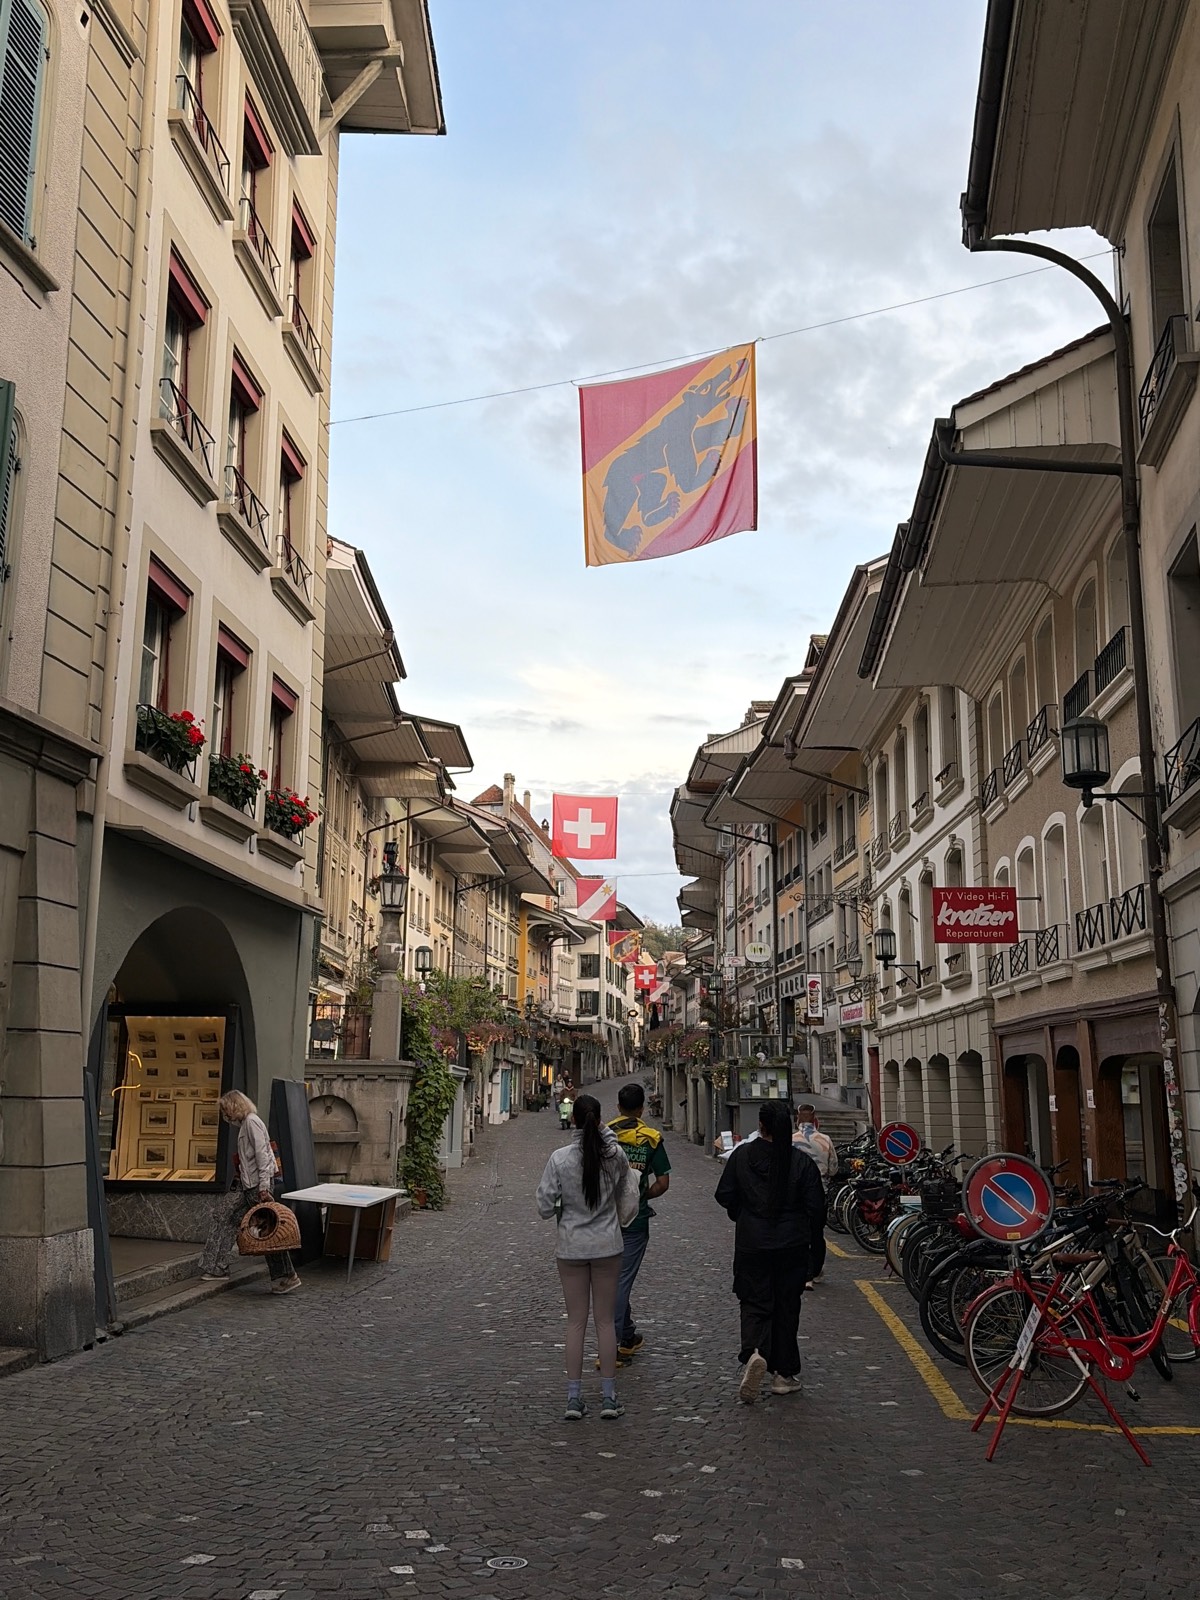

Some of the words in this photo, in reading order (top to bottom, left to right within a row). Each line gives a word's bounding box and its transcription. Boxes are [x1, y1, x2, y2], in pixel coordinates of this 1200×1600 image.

[940, 892, 953, 901] TV
[957, 892, 984, 901] Video
[987, 892, 1009, 901] Hi-Fi
[937, 901, 1014, 926] kratzer
[946, 929, 1004, 939] Reparaturen
[626, 1153, 646, 1162] YOUR
